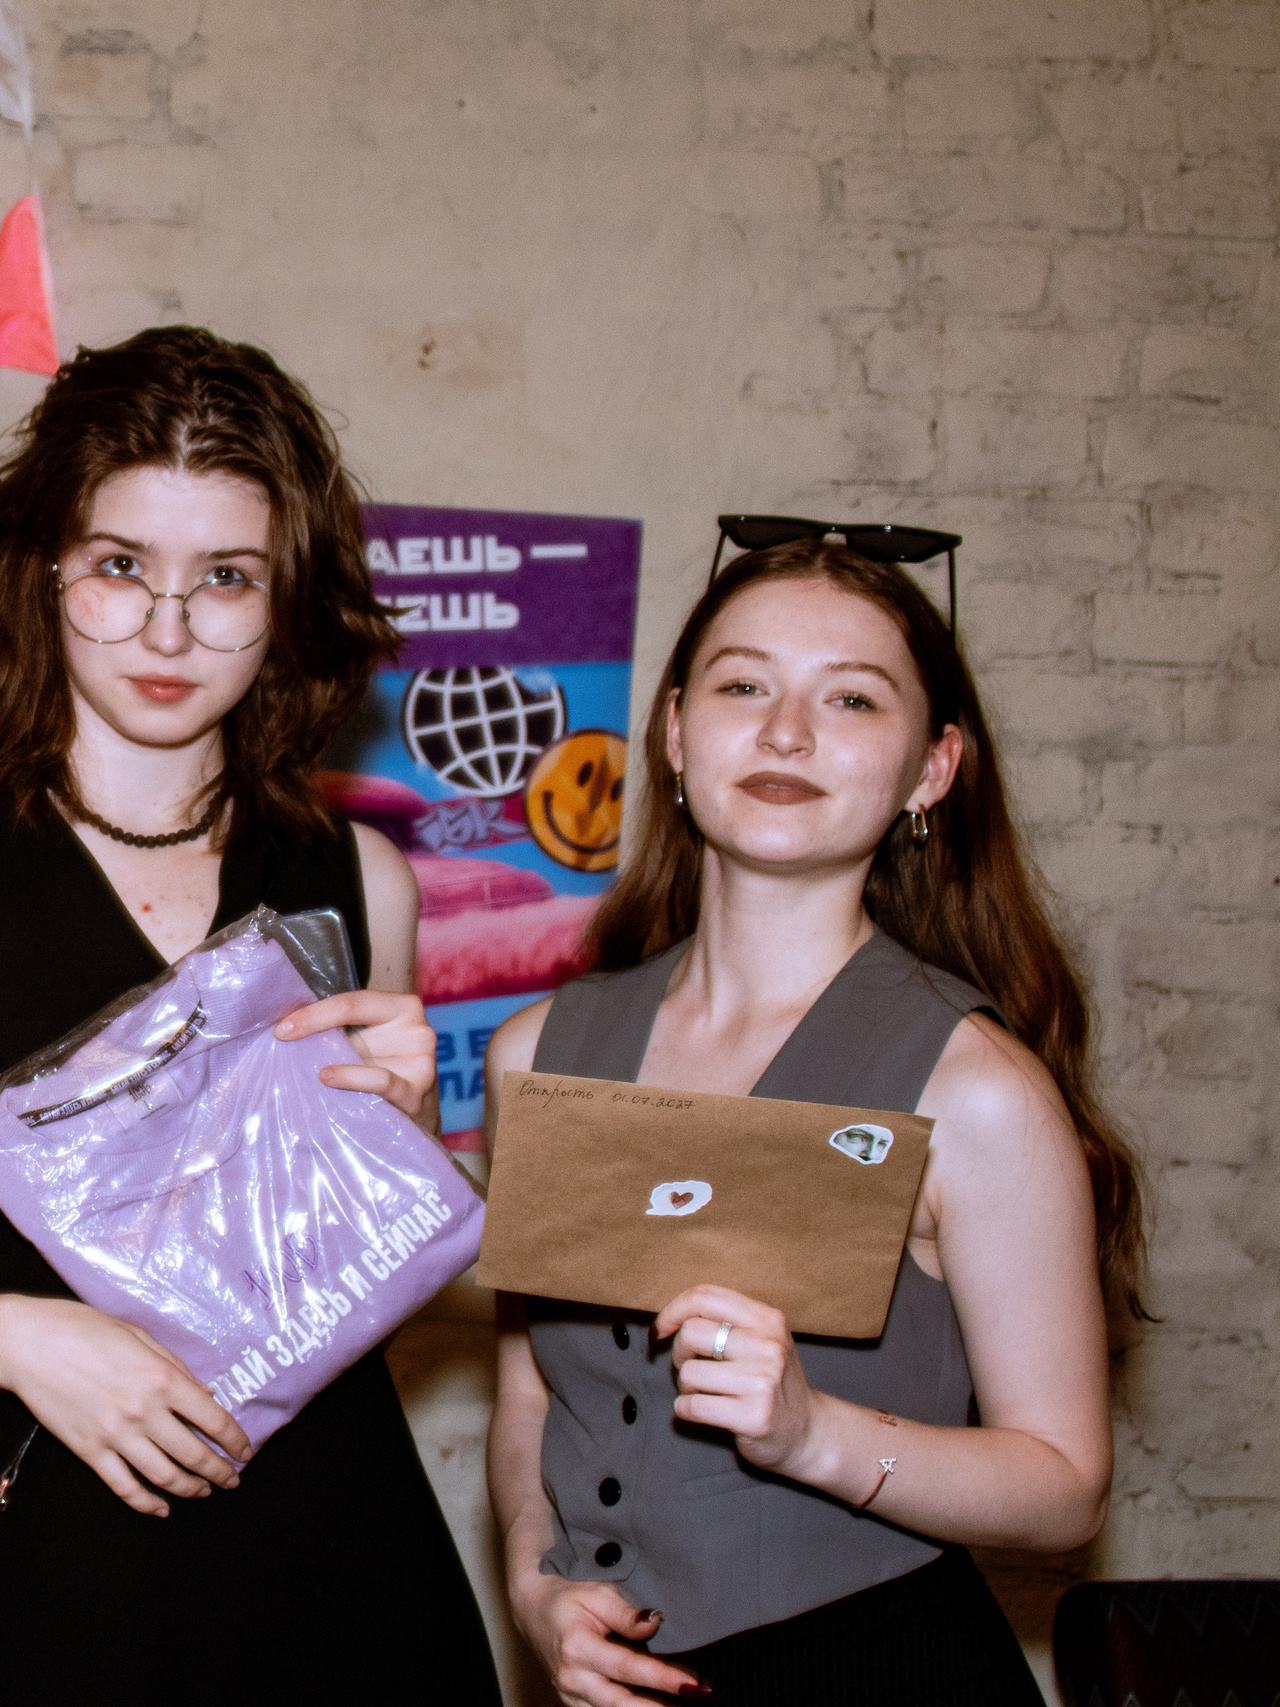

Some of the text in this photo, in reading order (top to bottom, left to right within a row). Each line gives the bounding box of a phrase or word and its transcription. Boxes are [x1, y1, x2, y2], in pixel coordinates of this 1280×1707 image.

[365, 534, 522, 576] АЕШЬ
[376, 592, 520, 633] ЕШЬ
[519, 1079, 697, 1110] Открыть 01.07.2027
[208, 1191, 452, 1412] ОТАЙ ЗДЕСЬ И СЕЙЧАС
